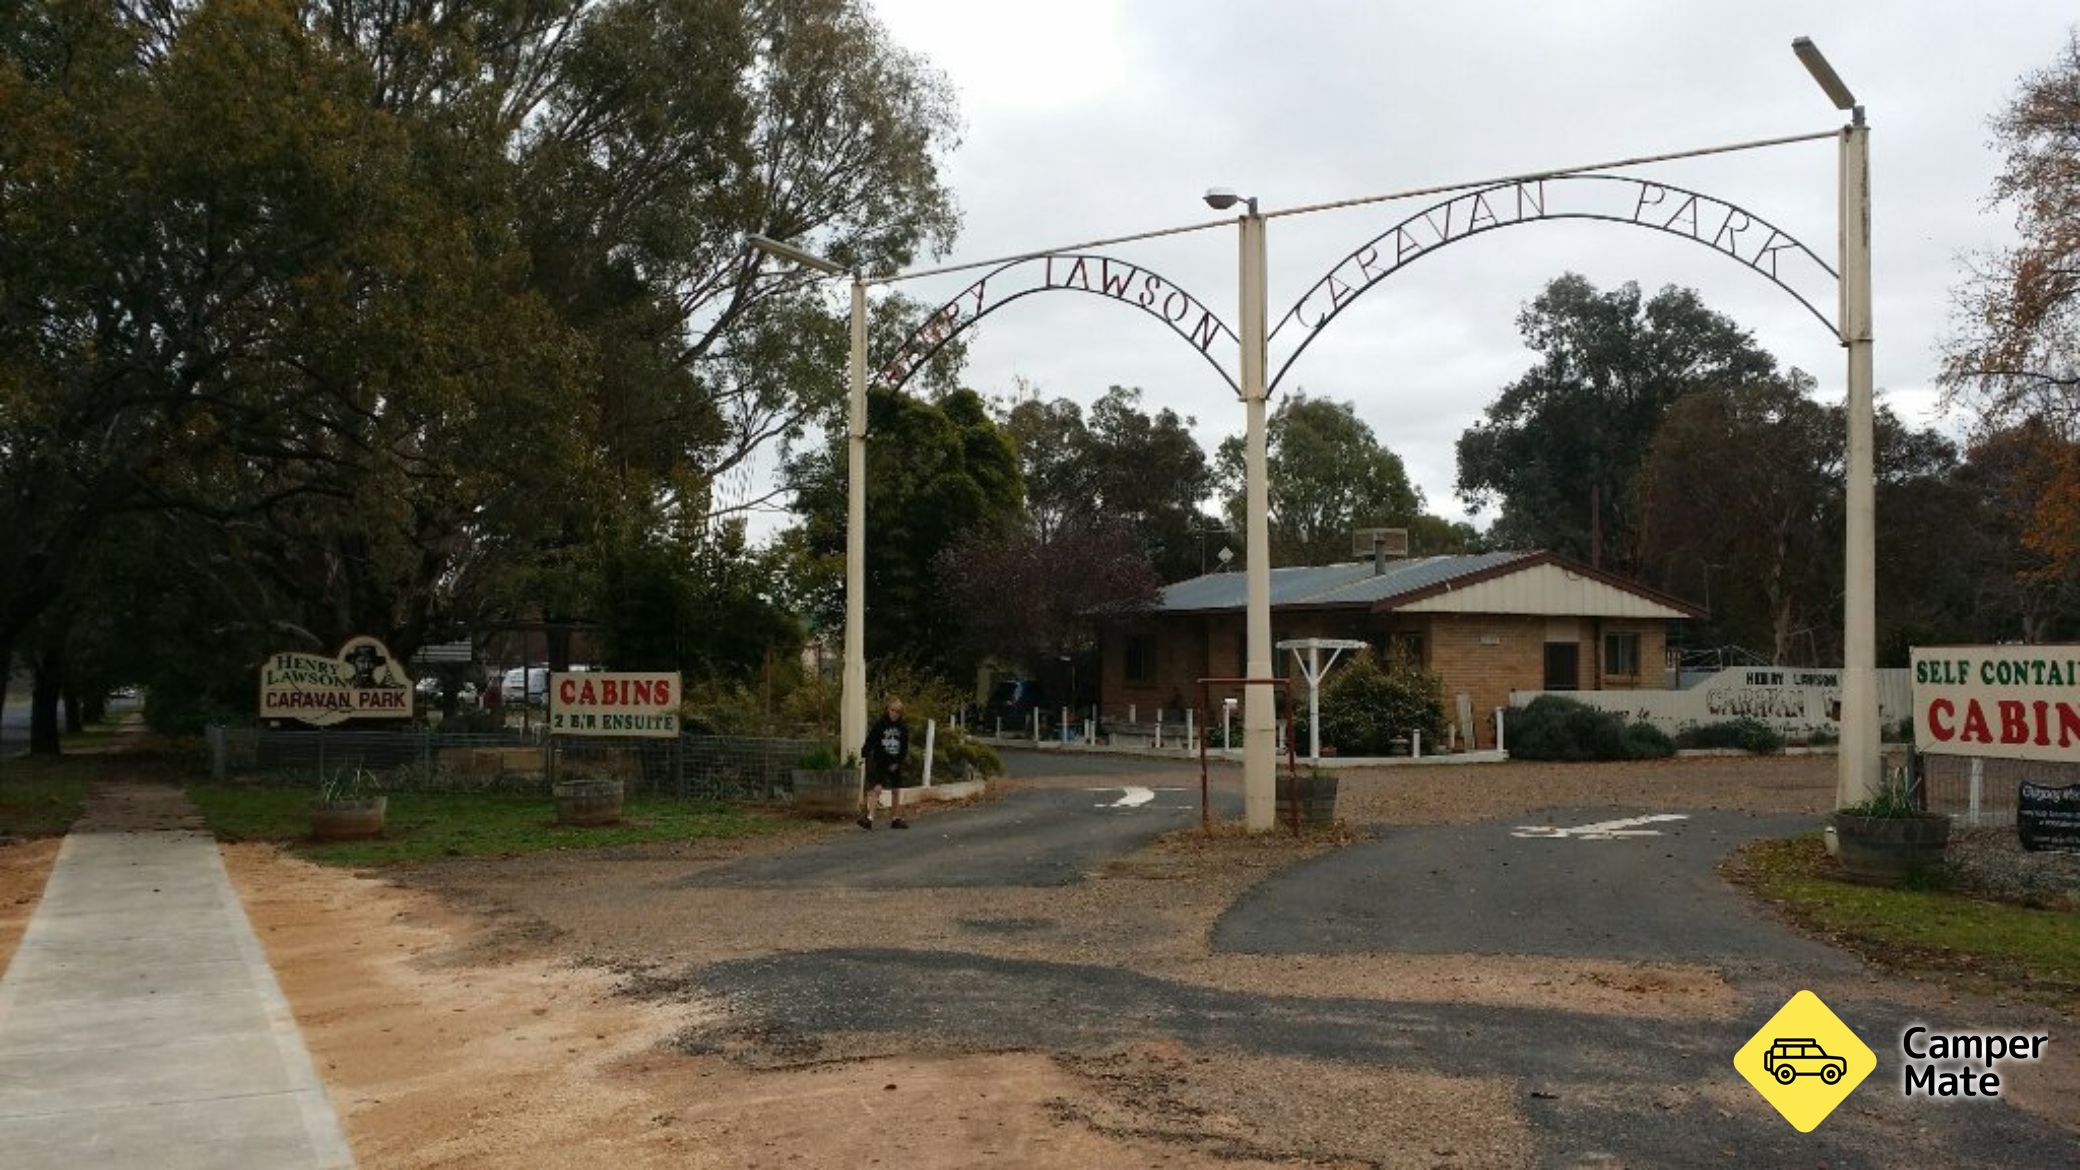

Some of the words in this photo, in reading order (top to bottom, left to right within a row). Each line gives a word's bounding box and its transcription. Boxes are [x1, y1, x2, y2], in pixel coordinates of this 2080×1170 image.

[1295, 179, 1545, 329] CARAVAN
[1634, 182, 1800, 281] PARK
[1045, 256, 1220, 352] LAWSON
[276, 655, 338, 675] HENRY
[1916, 659, 1970, 685] SELF
[1980, 659, 2080, 686] CONTAI
[266, 670, 347, 688] LAWSON
[265, 691, 352, 708] CARAVAN
[358, 691, 406, 708] PARK
[560, 679, 670, 705] CABINS
[554, 714, 564, 728] 2
[602, 714, 673, 731] ENSUITE
